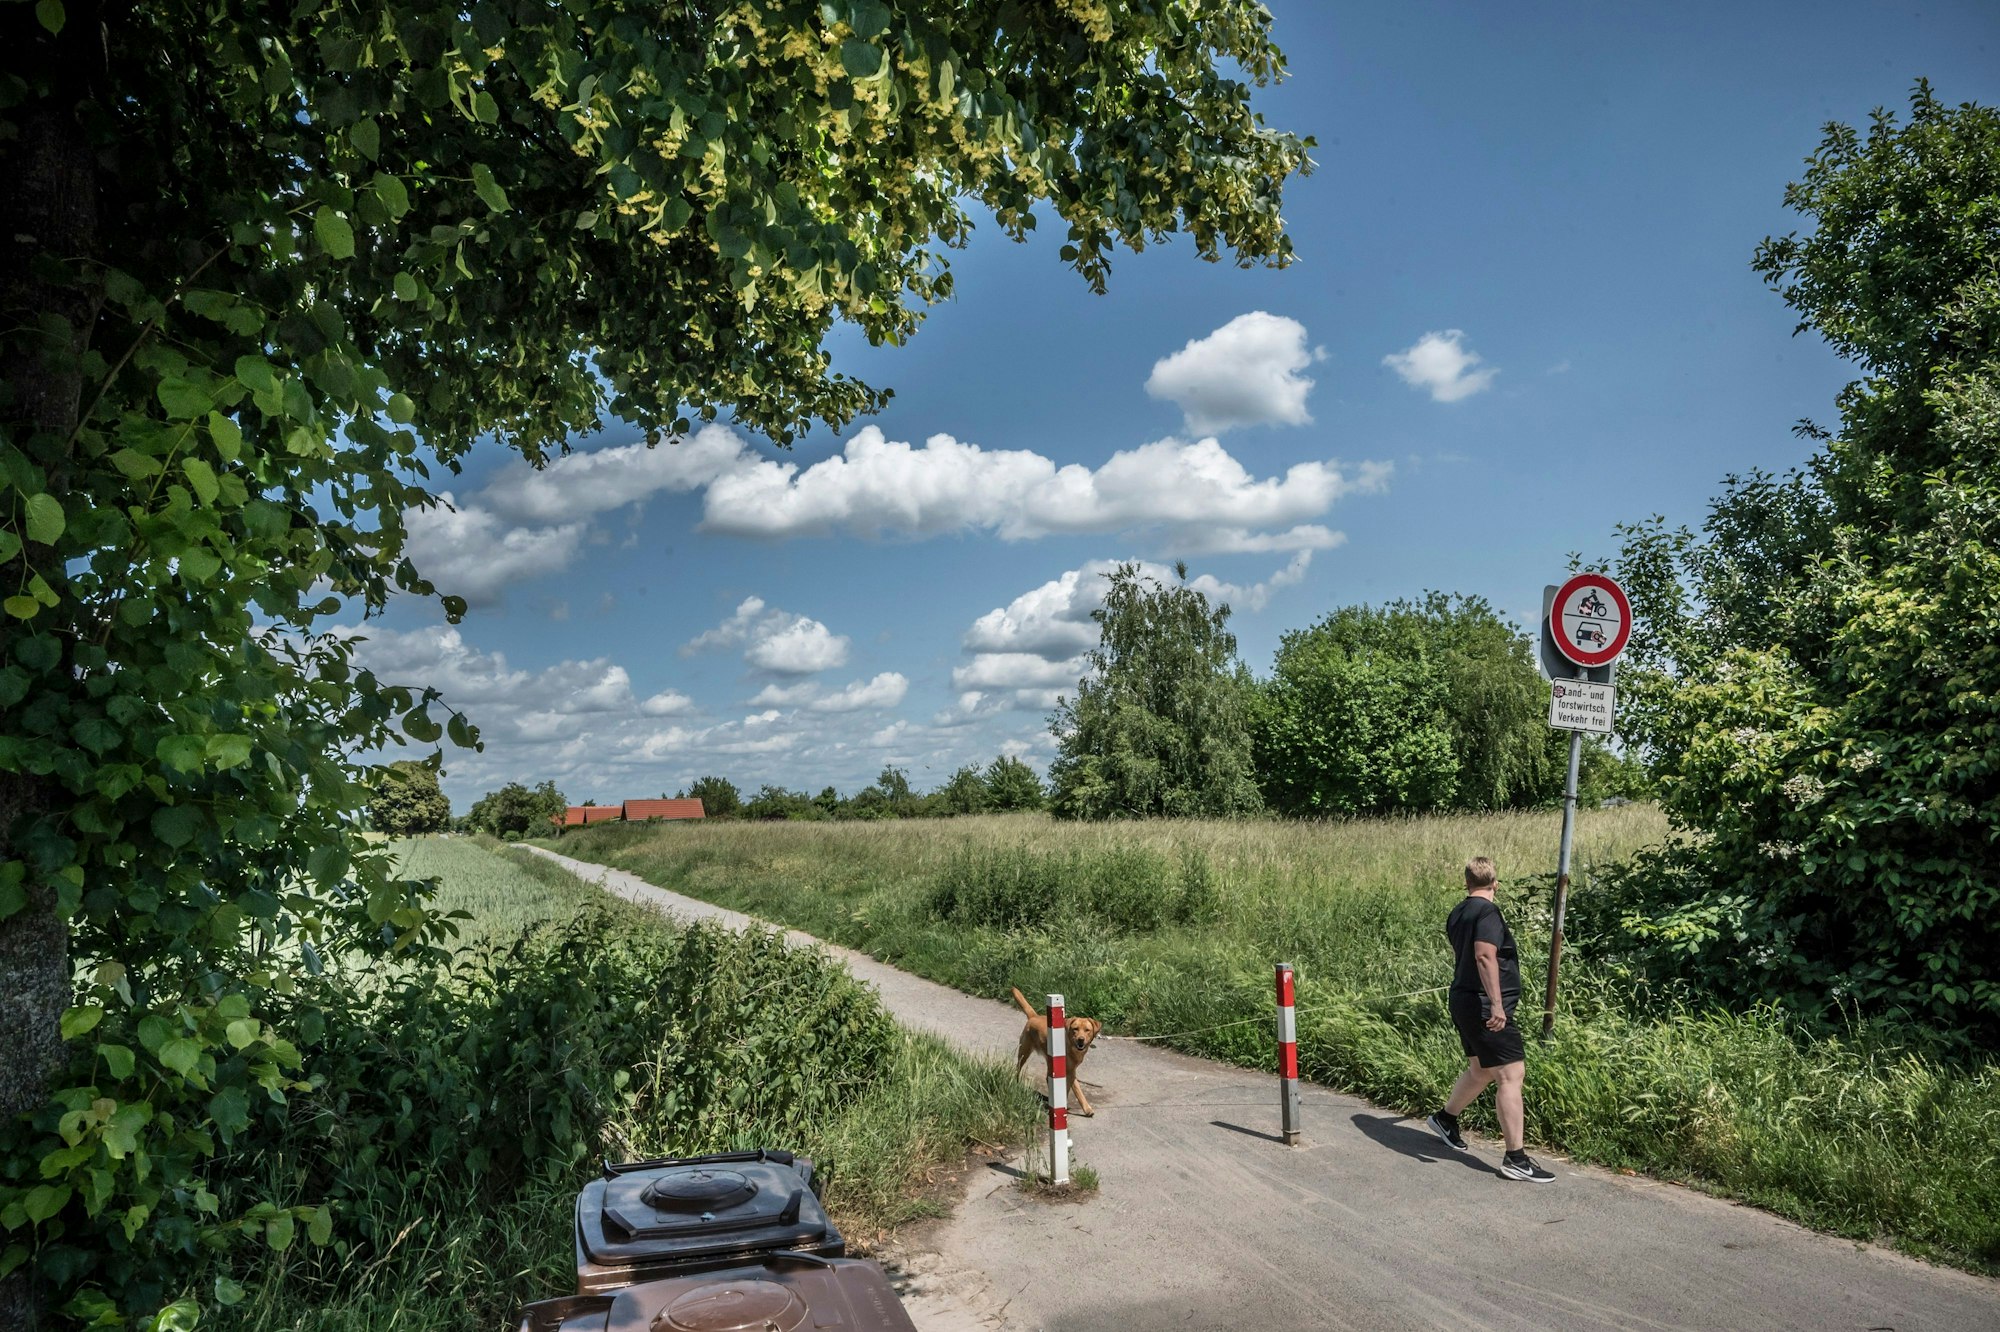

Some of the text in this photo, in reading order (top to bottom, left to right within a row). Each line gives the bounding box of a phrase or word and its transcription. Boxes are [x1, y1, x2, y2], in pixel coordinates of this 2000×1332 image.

[1590, 691, 1605, 700] und
[1558, 699, 1608, 714] forstwirtsch.
[1558, 711, 1606, 726] Verkehr frei
